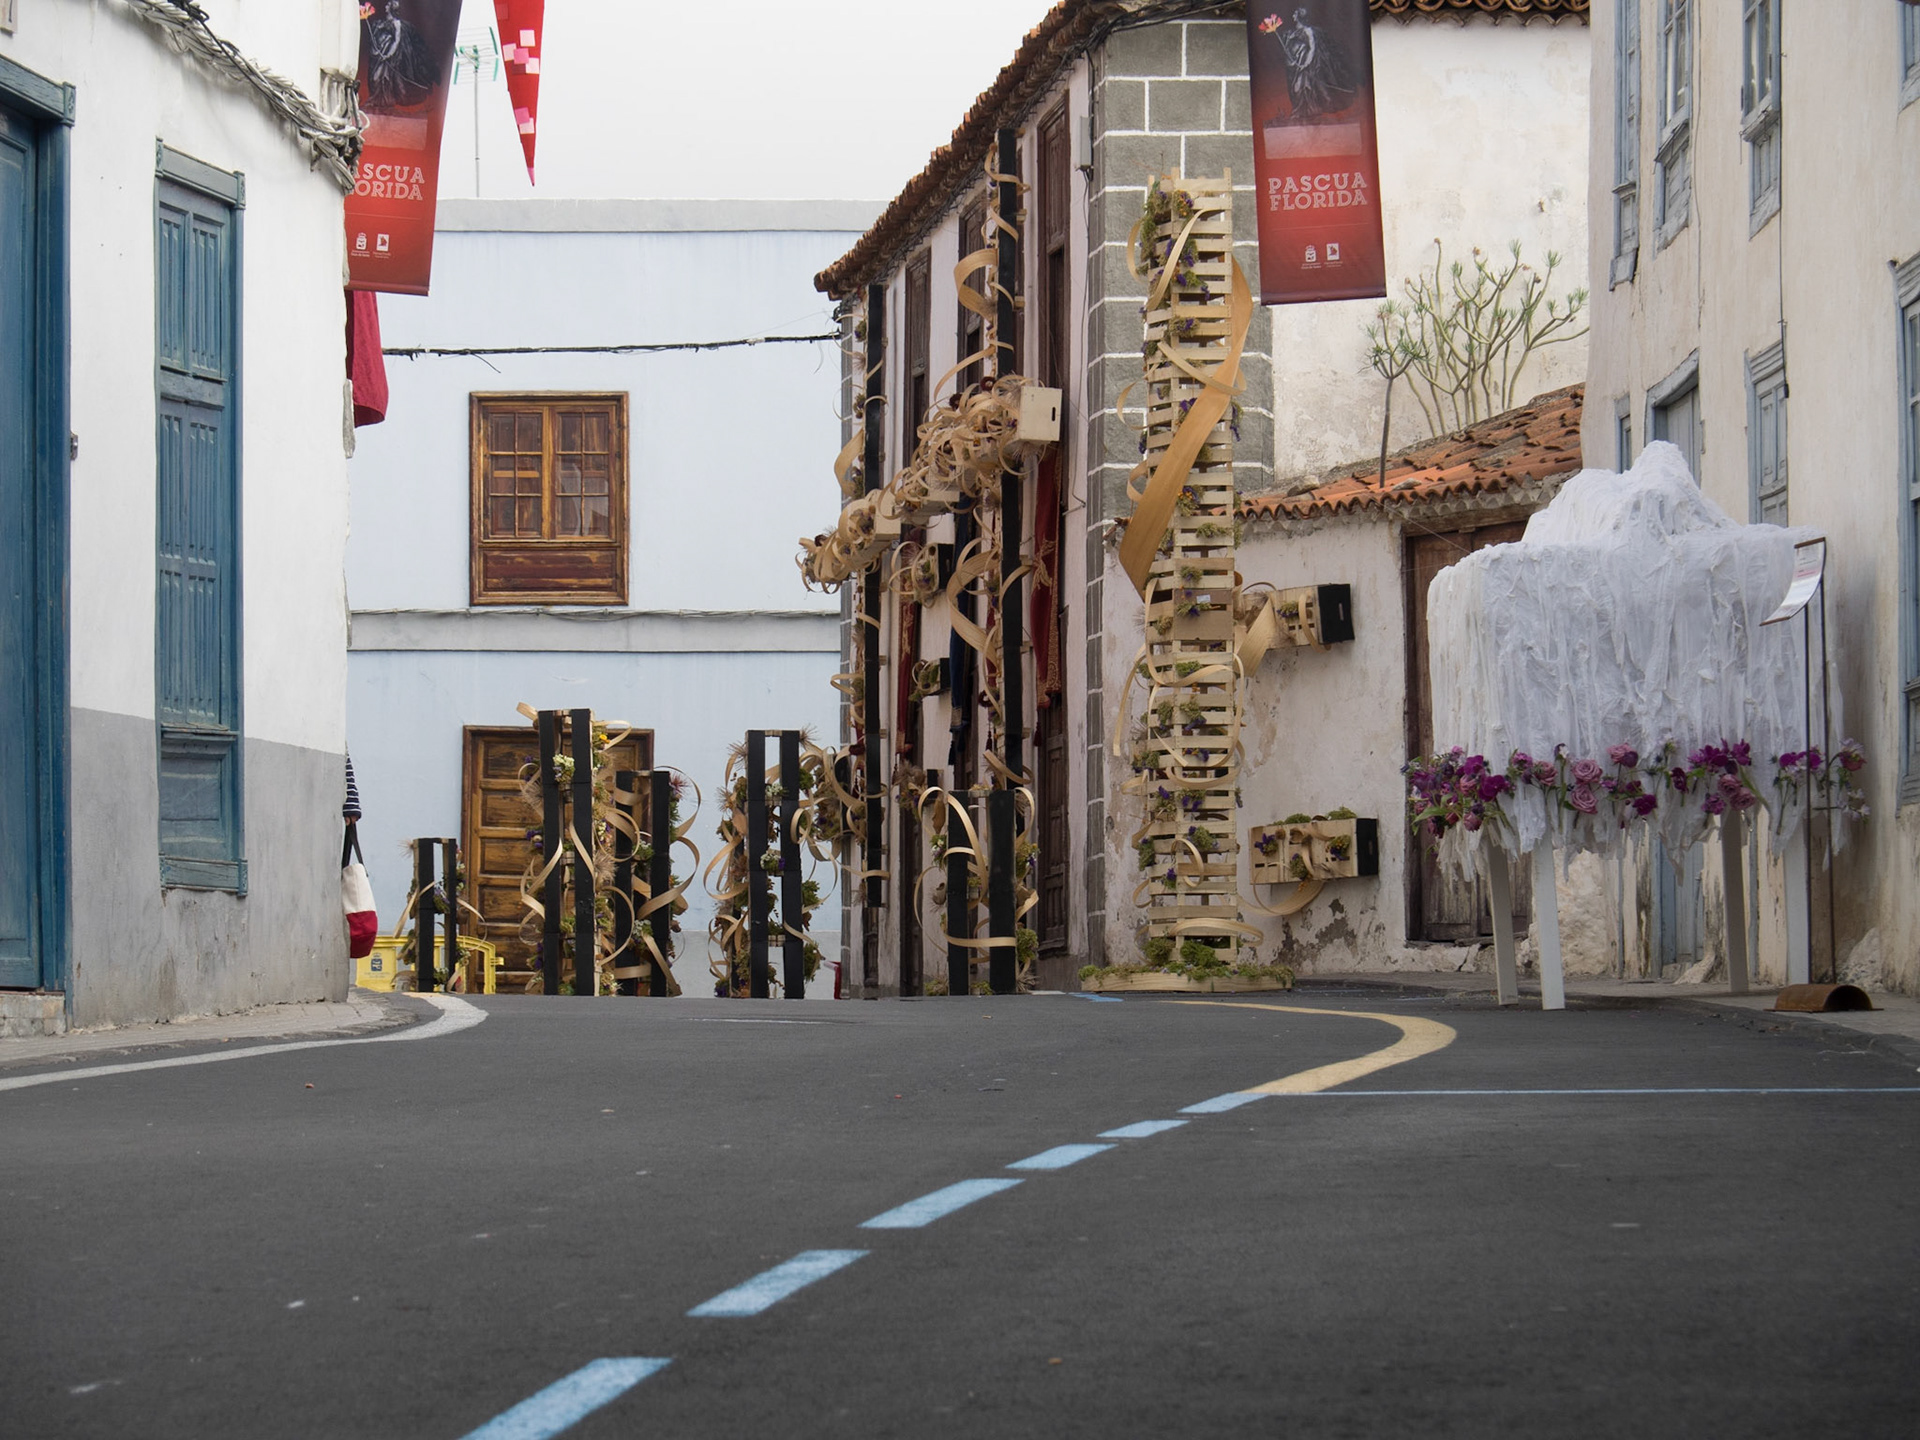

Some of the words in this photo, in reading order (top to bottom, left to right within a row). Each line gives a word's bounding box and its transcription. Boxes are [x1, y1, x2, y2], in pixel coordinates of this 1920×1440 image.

[351, 180, 423, 201] ORIDA
[1268, 172, 1367, 194] PASCUA
[1269, 189, 1368, 211] FLORIDA
